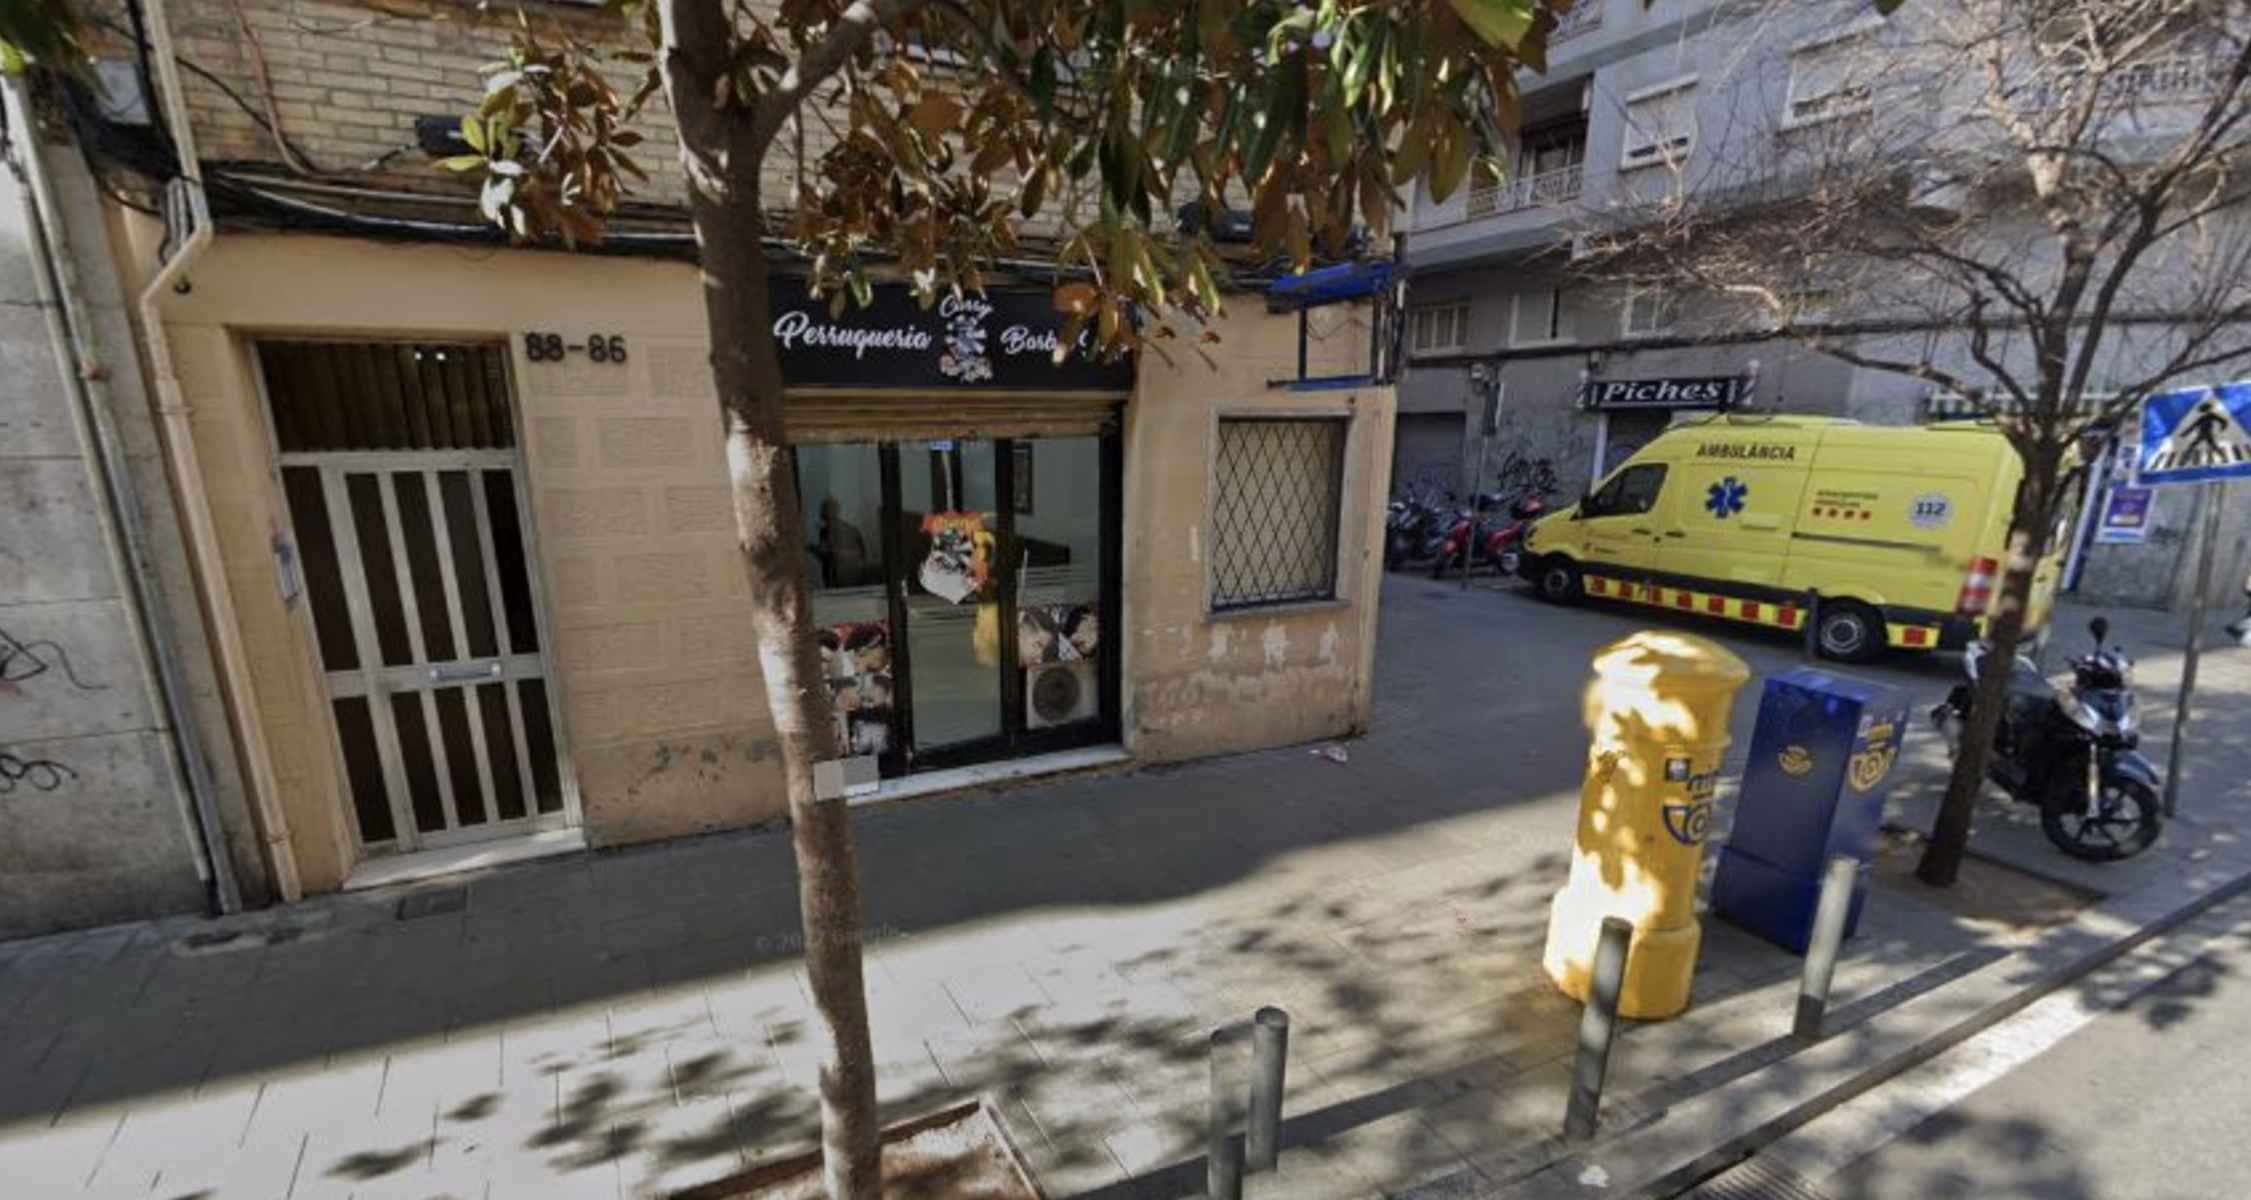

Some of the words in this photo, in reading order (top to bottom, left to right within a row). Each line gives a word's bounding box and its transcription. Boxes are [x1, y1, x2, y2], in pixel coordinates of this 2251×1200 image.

[525, 332, 626, 362] 88-86
[1603, 381, 1720, 400] Piches
[1916, 502, 1946, 515] 112
